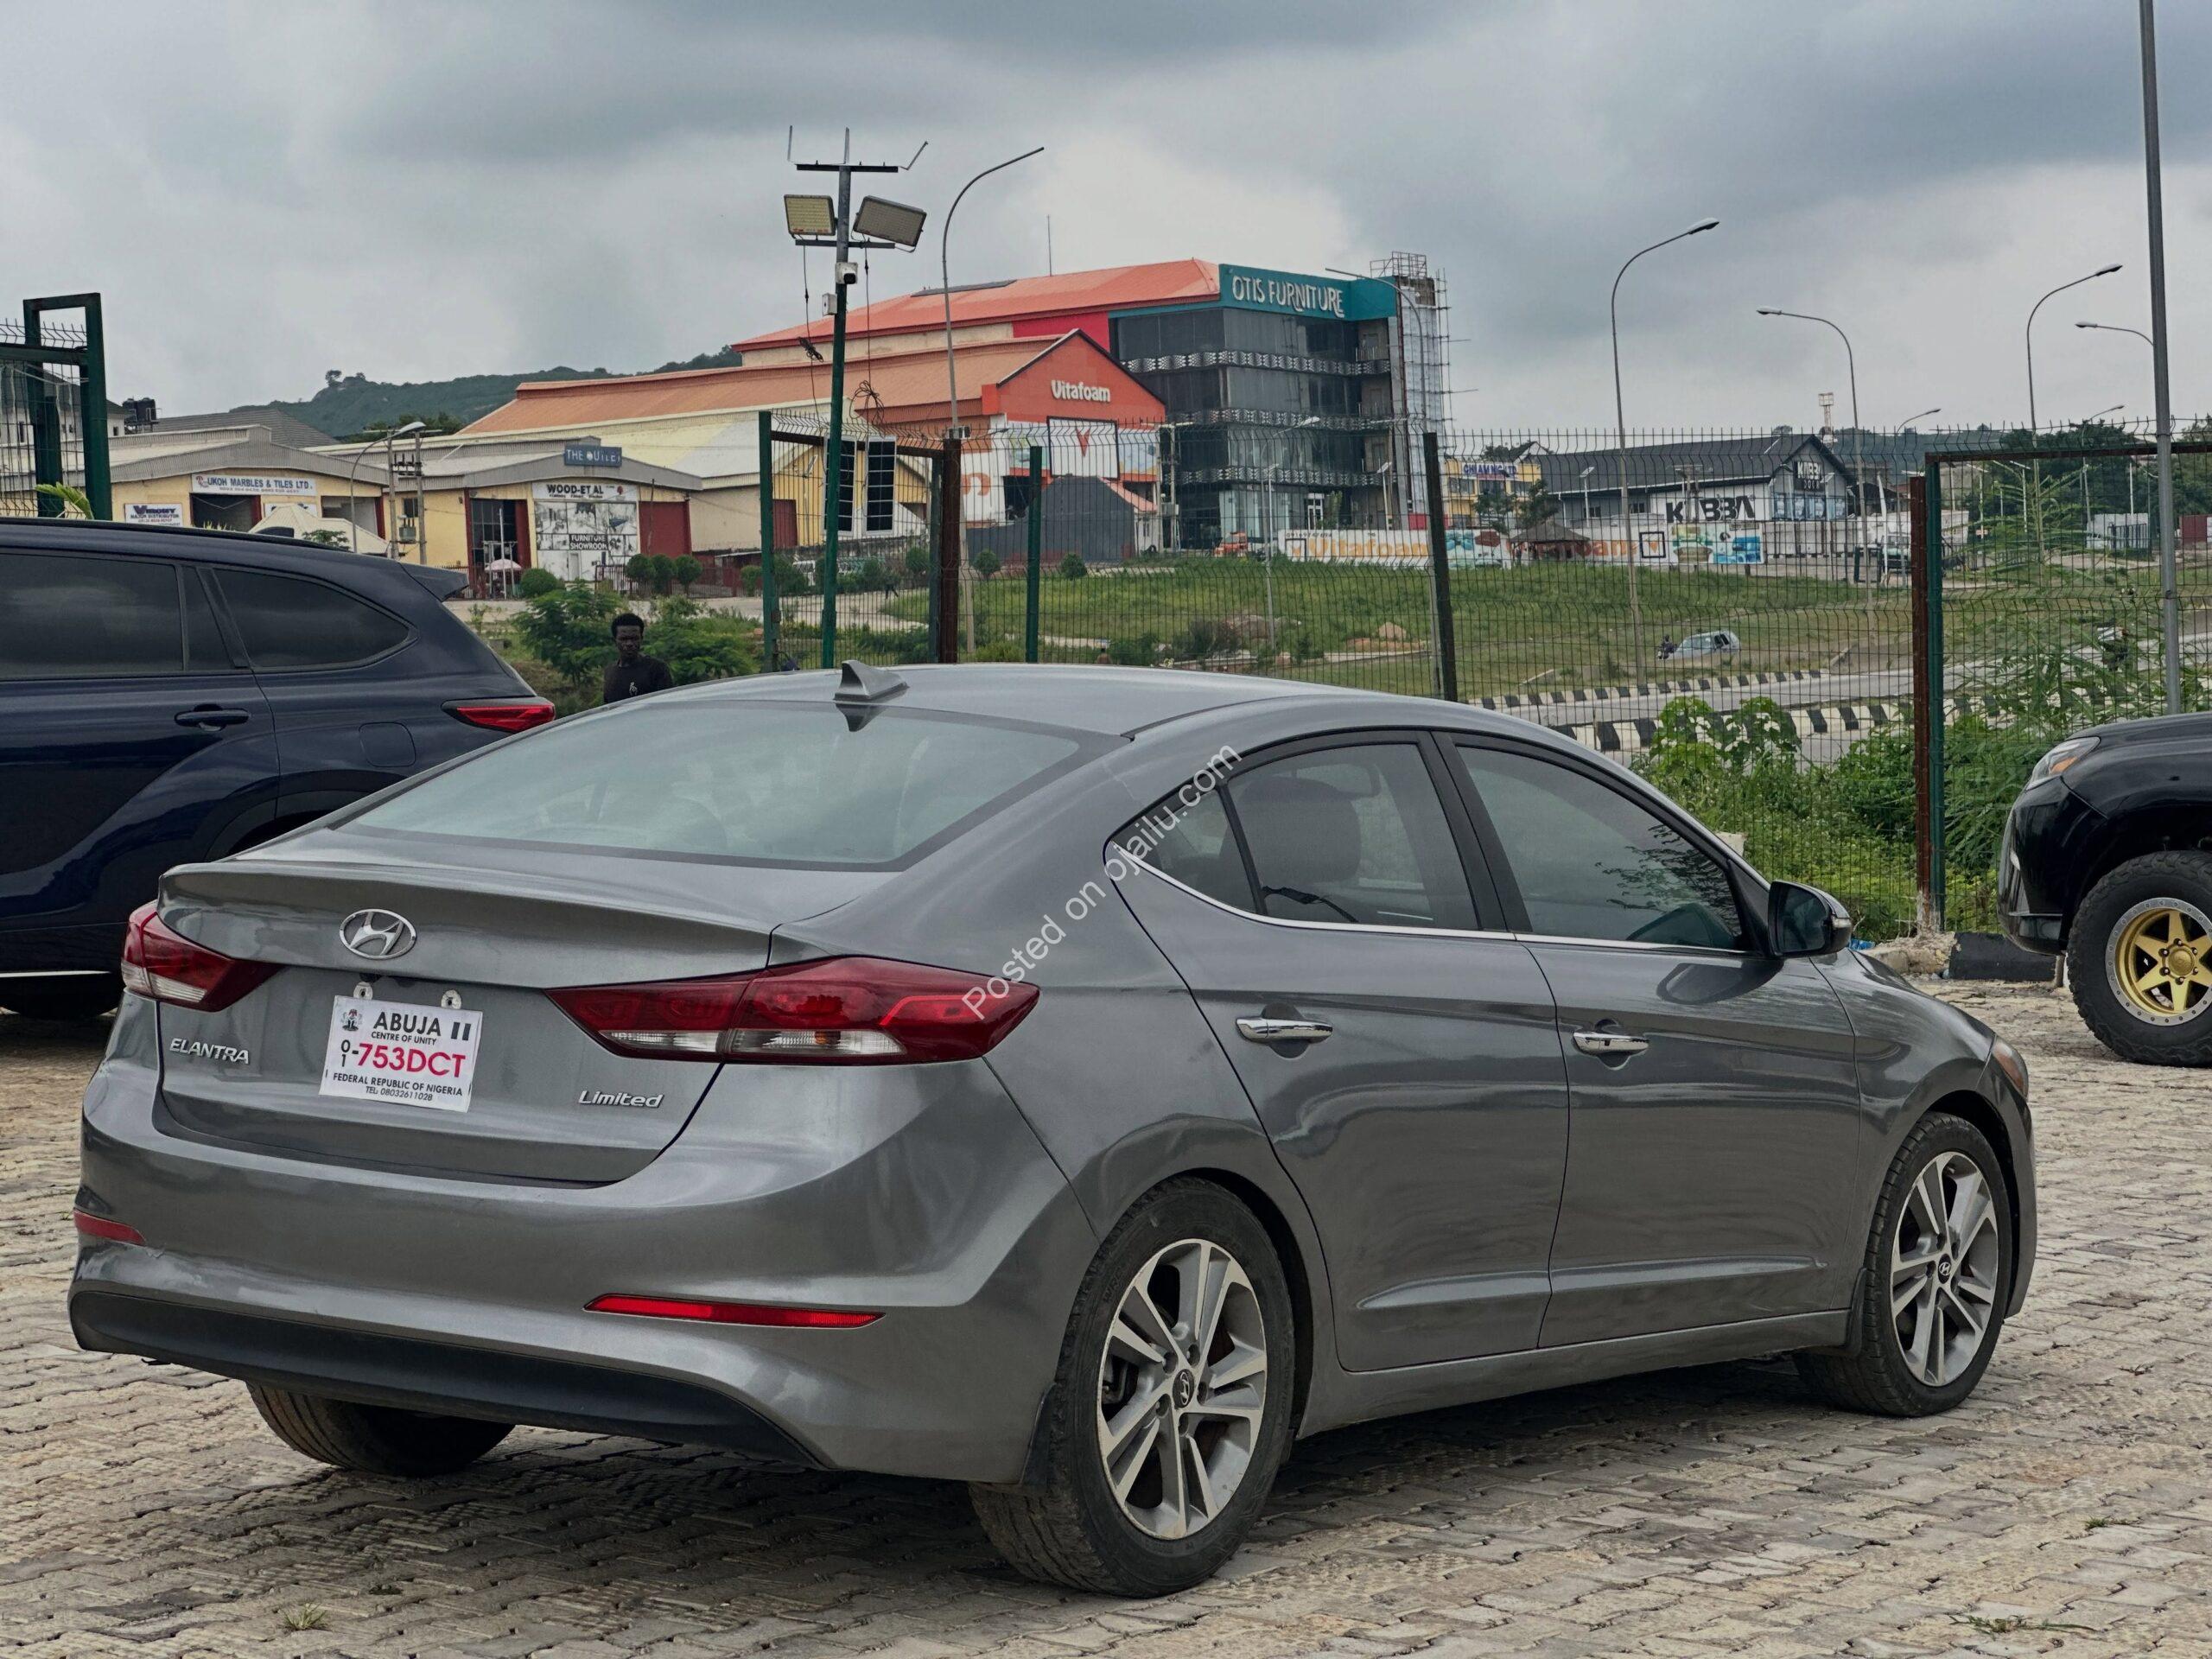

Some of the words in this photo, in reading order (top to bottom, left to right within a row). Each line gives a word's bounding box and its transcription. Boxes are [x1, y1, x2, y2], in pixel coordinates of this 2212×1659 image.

[1232, 276, 1265, 302] OTIS
[1268, 280, 1344, 318] FURNITURE
[1051, 379, 1110, 403] Vitafoam
[567, 449, 583, 461] THE
[230, 478, 264, 488] MARBLES
[266, 480, 272, 488] &
[273, 480, 294, 489] TILES
[594, 486, 604, 494] AL
[1666, 495, 1755, 524] KBBA
[373, 1011, 442, 1037] ABUJA
[372, 1031, 399, 1041] CENTRE
[414, 1036, 436, 1046] UNITY
[169, 1038, 250, 1065] ELANTRA
[333, 1072, 368, 1085] FEDERAL
[372, 1077, 410, 1090] REPUBLIC
[412, 1083, 424, 1091] OF
[426, 1084, 462, 1096] NIGERIA
[380, 1088, 432, 1101] 08032611028
[578, 1090, 664, 1108] Limited
